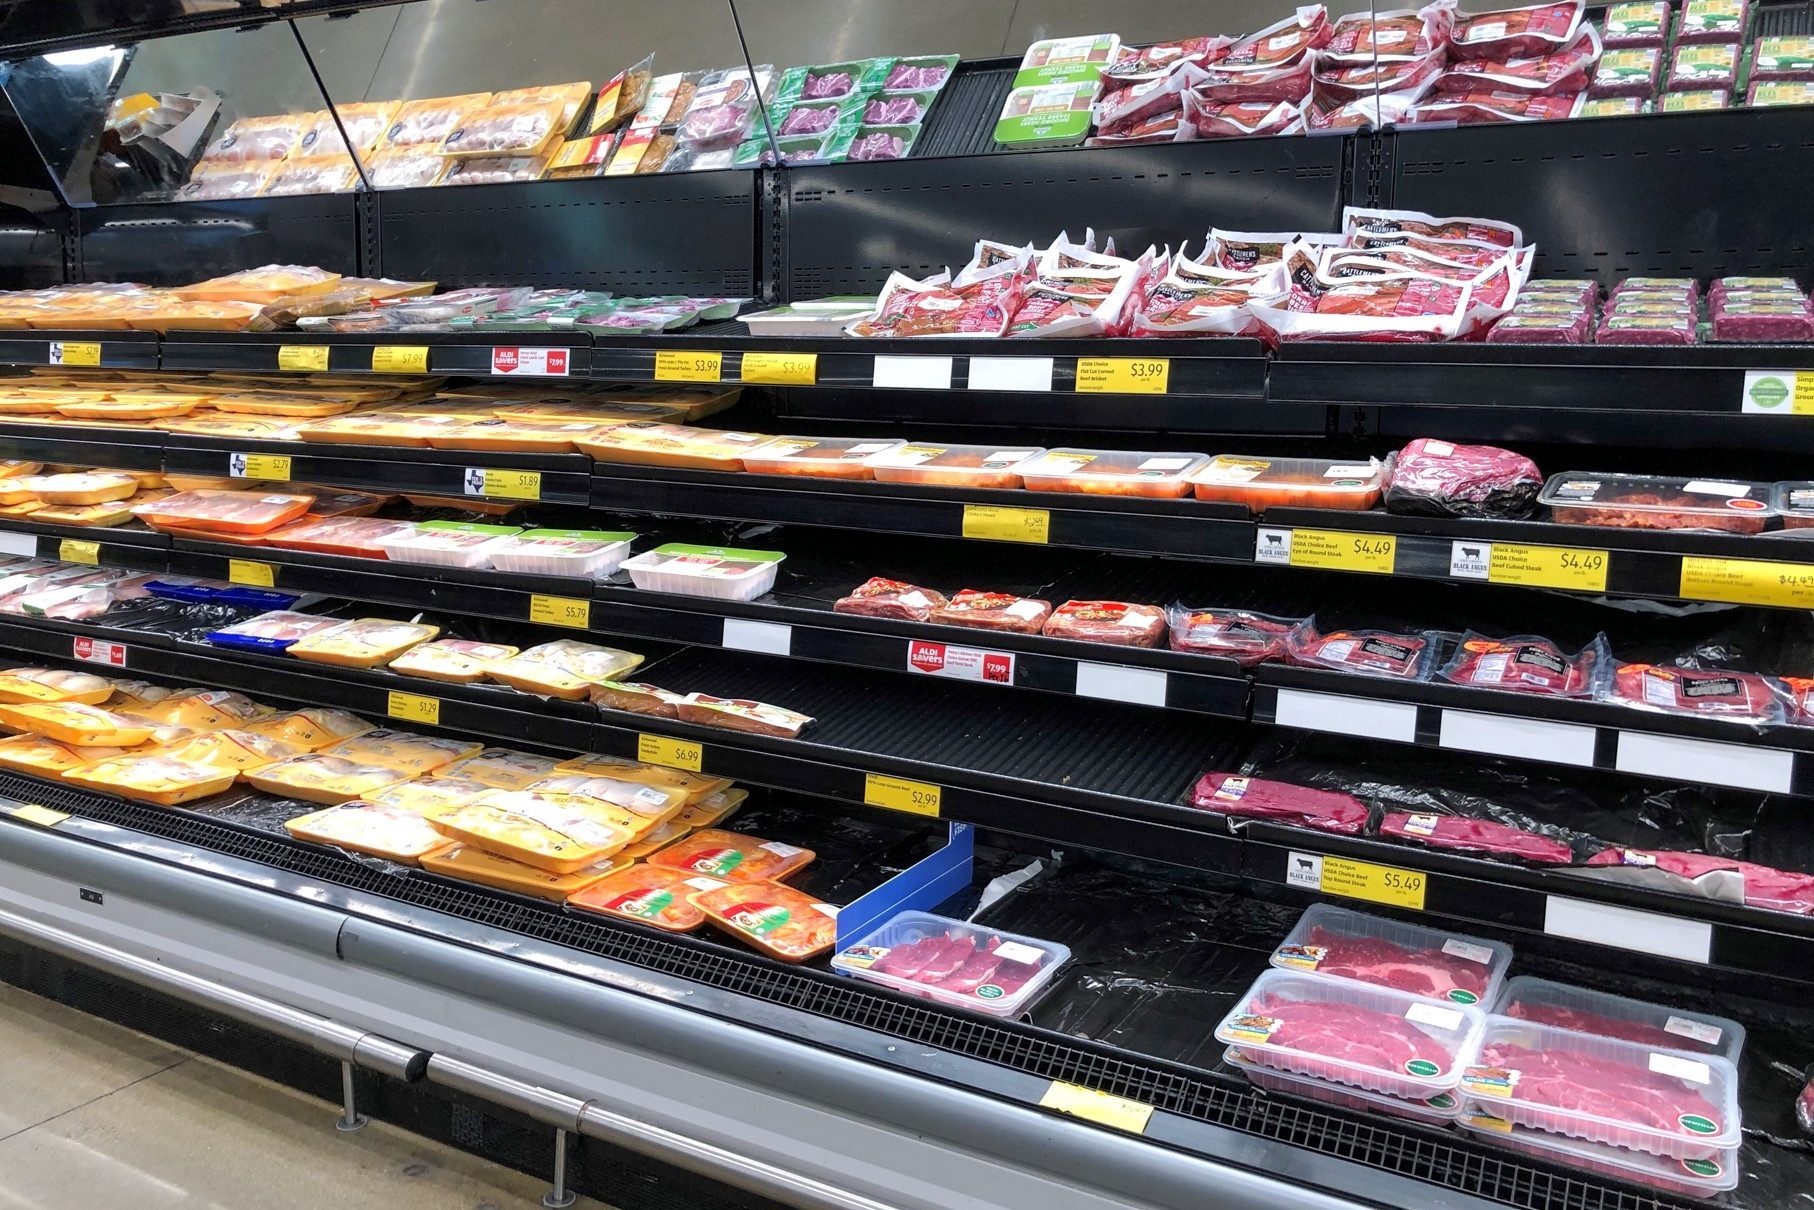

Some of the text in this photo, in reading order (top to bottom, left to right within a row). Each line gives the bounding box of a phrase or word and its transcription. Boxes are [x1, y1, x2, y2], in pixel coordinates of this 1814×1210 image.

[695, 359, 718, 372] $3.99
[782, 361, 811, 375] $3.99
[1130, 362, 1163, 378] $3.99
[272, 458, 289, 469] $2.79
[519, 475, 539, 487] $1.89
[1353, 539, 1391, 555] $4.49
[1510, 547, 1529, 555] Angus
[1560, 552, 1602, 570] $4.49
[565, 606, 587, 618] $5.79
[919, 647, 938, 656] ALDI
[912, 653, 943, 664] savers
[986, 662, 1006, 673] $7.99
[419, 701, 437, 713] $1.29
[675, 747, 699, 762] $6.99
[912, 790, 938, 806] $2.99
[1324, 860, 1356, 871] Black Angus
[1289, 871, 1304, 879] BLACK
[1323, 867, 1338, 875] USDA
[1338, 869, 1355, 878] Choice
[1355, 872, 1368, 880] Beef
[1333, 877, 1351, 885] Round
[1384, 871, 1421, 891] $5.49
